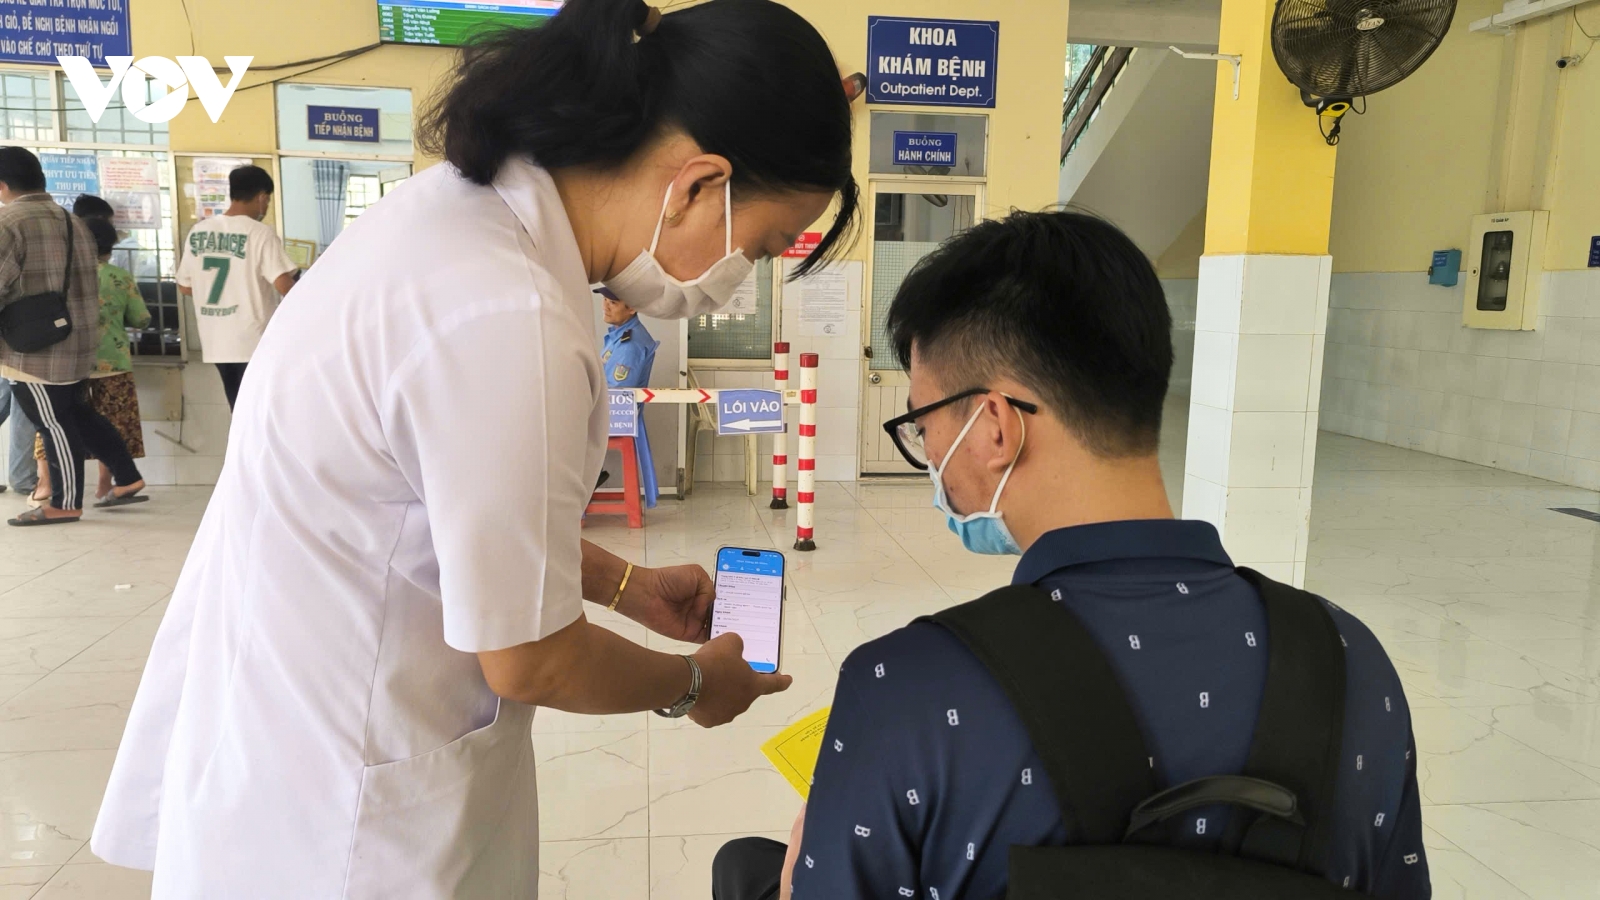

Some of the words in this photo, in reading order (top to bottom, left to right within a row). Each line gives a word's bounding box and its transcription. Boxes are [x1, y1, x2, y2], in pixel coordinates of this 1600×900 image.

[35, 17, 54, 35] NGHỊ
[55, 15, 76, 35] BỆNH
[78, 16, 99, 34] NHÂN
[910, 27, 957, 46] KHOA
[1, 36, 17, 55] VÀO
[18, 36, 34, 55] GHẾ
[36, 38, 52, 57] CHỜ
[53, 42, 74, 57] THEO
[92, 43, 104, 62] TỰ
[878, 53, 931, 76] KHÁM
[937, 55, 986, 81] BỆNH
[880, 82, 946, 97] Outpatient
[950, 84, 982, 99] Dept.
[324, 110, 363, 122] BUỒNG
[314, 121, 331, 135] TIẾP
[332, 123, 352, 138] NHẬN
[353, 124, 374, 139] BỆNH
[908, 135, 942, 147] BUỒNG
[898, 147, 922, 161] HÀNH
[925, 149, 951, 162] CHÍNH
[55, 181, 71, 190] THU
[73, 181, 86, 191] PHÍ
[202, 255, 231, 306] 7
[608, 394, 634, 405] IOS
[750, 398, 780, 413] VÀO
